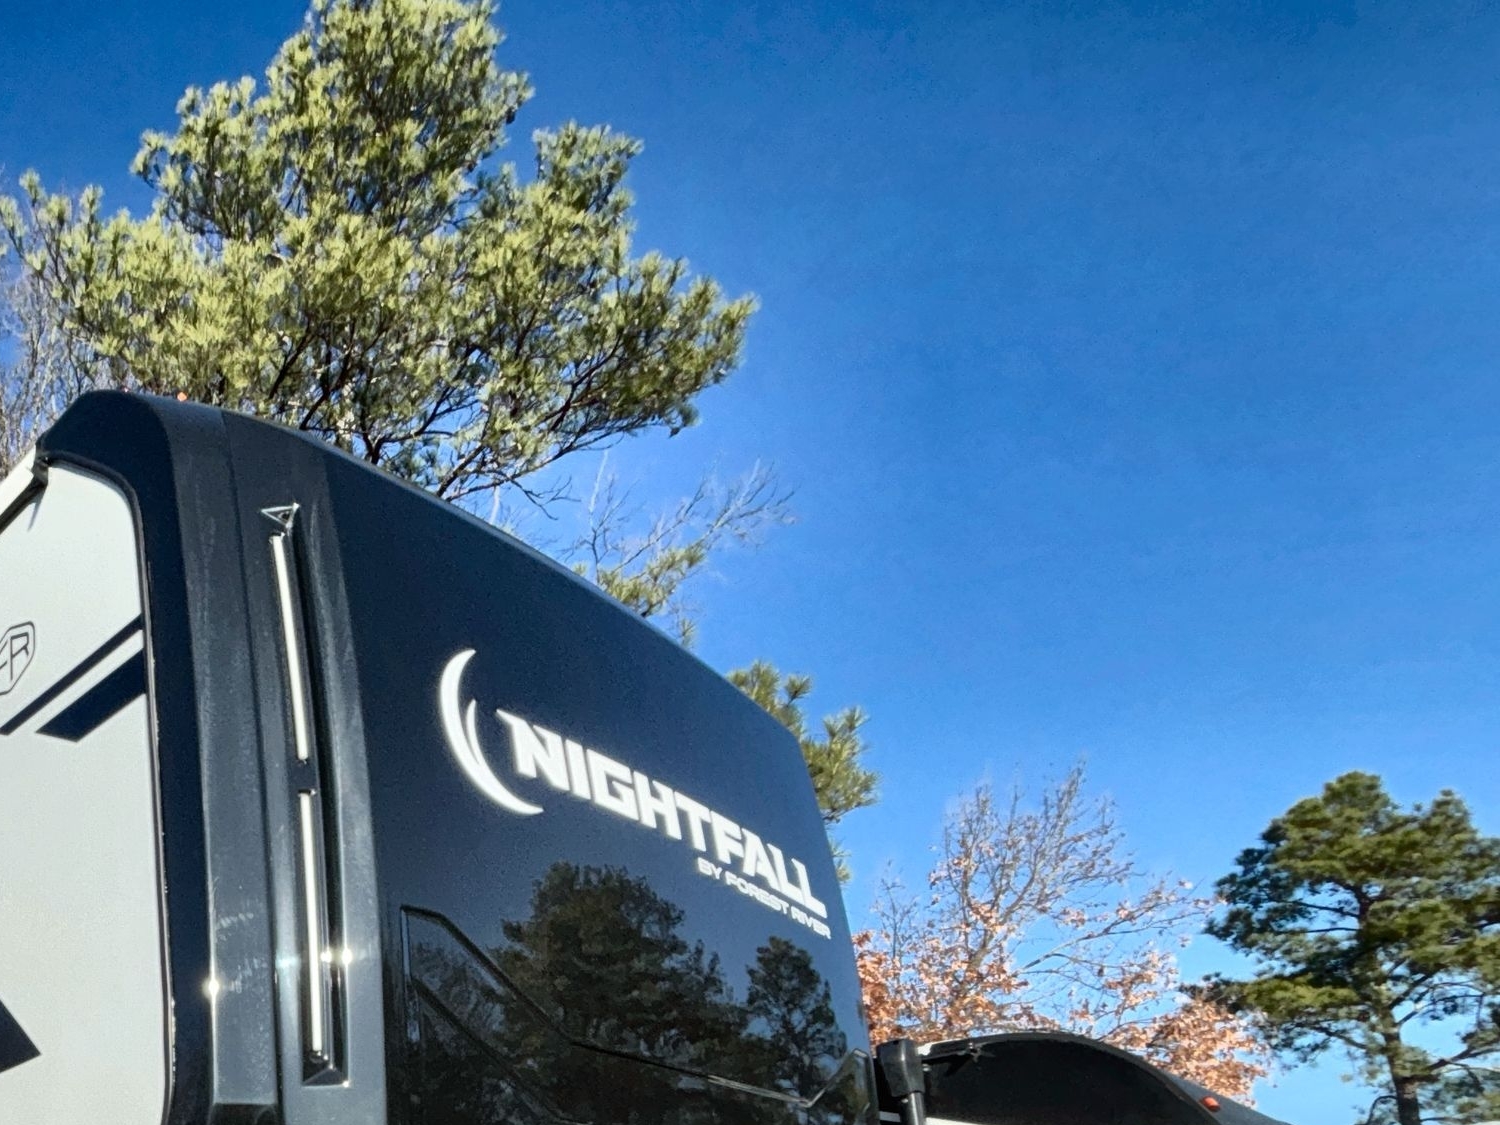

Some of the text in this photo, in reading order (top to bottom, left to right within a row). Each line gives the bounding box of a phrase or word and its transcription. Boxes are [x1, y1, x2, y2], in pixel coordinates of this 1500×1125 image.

[496, 708, 828, 919] NIGHTFALL
[697, 857, 832, 940] BY FOREST RIVER
